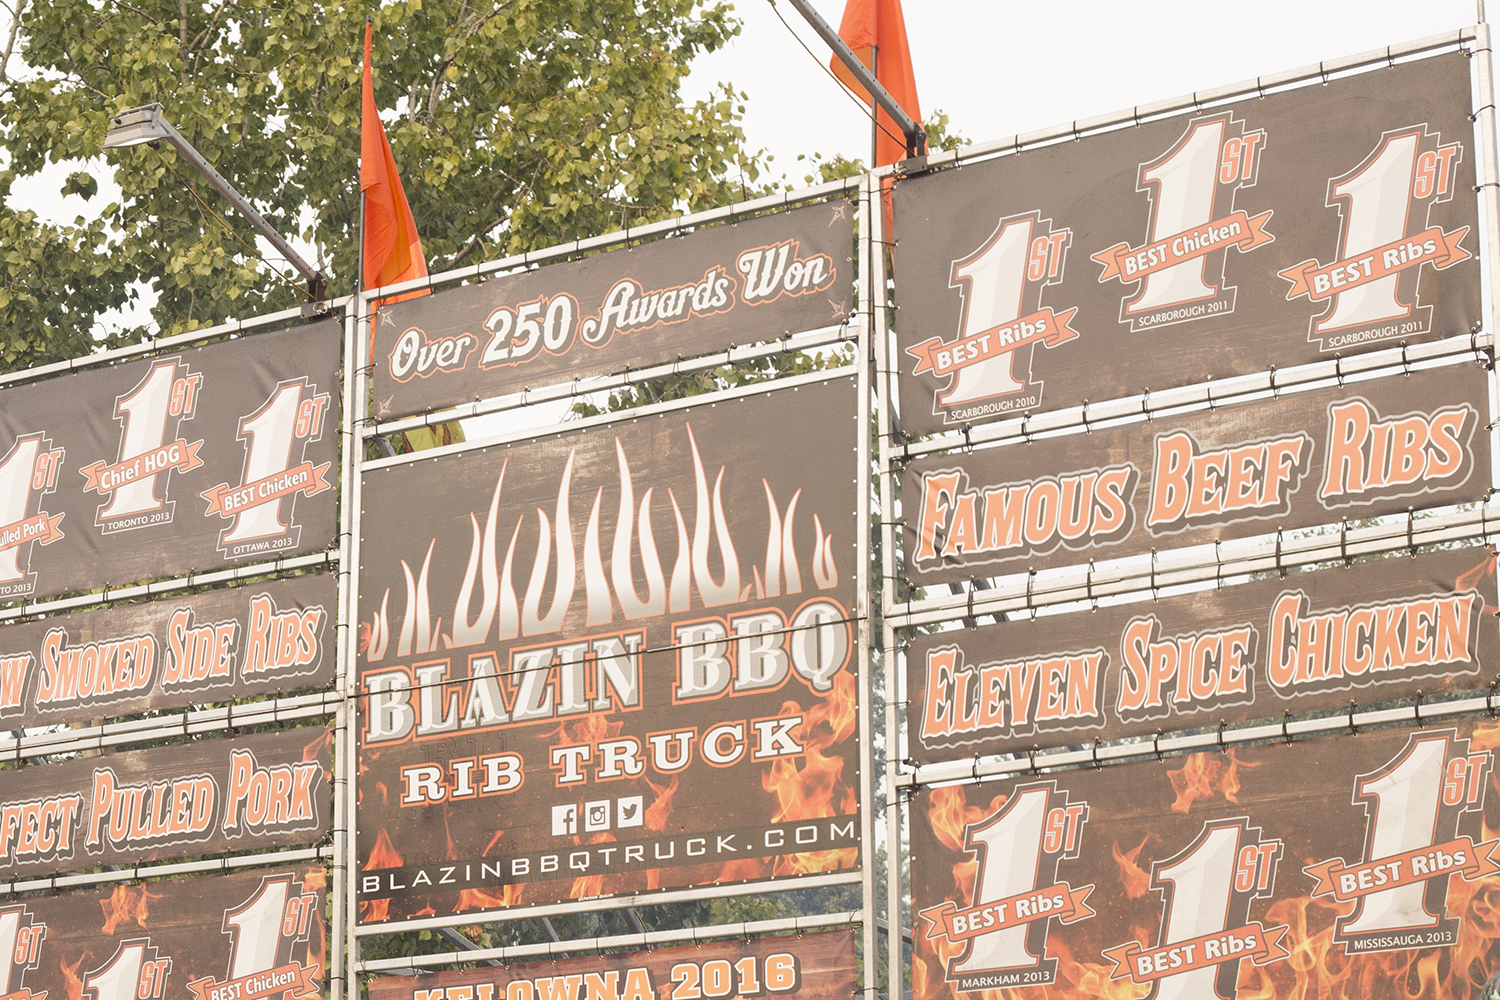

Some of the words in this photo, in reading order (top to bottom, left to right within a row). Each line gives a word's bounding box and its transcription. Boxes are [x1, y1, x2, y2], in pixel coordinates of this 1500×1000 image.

[1124, 242, 1167, 275] BEST
[1172, 218, 1242, 258] Chicken
[1313, 258, 1374, 294] BEST
[1384, 236, 1437, 270] Ribs
[390, 328, 473, 380] Over
[481, 294, 574, 365] 250
[582, 274, 730, 345] Awards
[737, 241, 831, 301] Won
[1139, 307, 1199, 326] SCARBOROUGH
[1201, 301, 1228, 315] 2011
[1329, 327, 1398, 347] SCARBOROUGH
[1400, 321, 1423, 334] 2011
[937, 337, 989, 370] BEST
[1000, 316, 1047, 348] Ribs
[951, 400, 1013, 420] SCARBOROUGH
[1016, 395, 1036, 409] 2010
[100, 456, 140, 488] Chief
[144, 445, 180, 471] HOG
[914, 468, 1134, 564] FAMOUS
[1149, 430, 1305, 529] BEEF
[1322, 399, 1470, 498] RIBS
[107, 514, 148, 530] TORONTO
[150, 511, 170, 522] 2013
[36, 628, 157, 706] SMOKED
[161, 608, 238, 688] SIDE
[241, 595, 325, 677] RIBS
[364, 634, 644, 743] BLAZIN
[675, 602, 850, 699] BBQ
[922, 646, 1105, 742] ELEVEN
[1117, 617, 1254, 716] SPICE
[1268, 592, 1477, 690] CHICKEN
[403, 755, 522, 804] RIB
[552, 717, 804, 784] TRUCK
[85, 768, 215, 848] PULLED
[222, 750, 320, 831] PORK
[363, 821, 855, 893] BLAZINBBQTRUCK.COM
[952, 909, 1008, 935] BEST
[1015, 892, 1065, 919] Ribs
[961, 973, 1020, 988] MARKHAM
[1023, 971, 1050, 983] 2013
